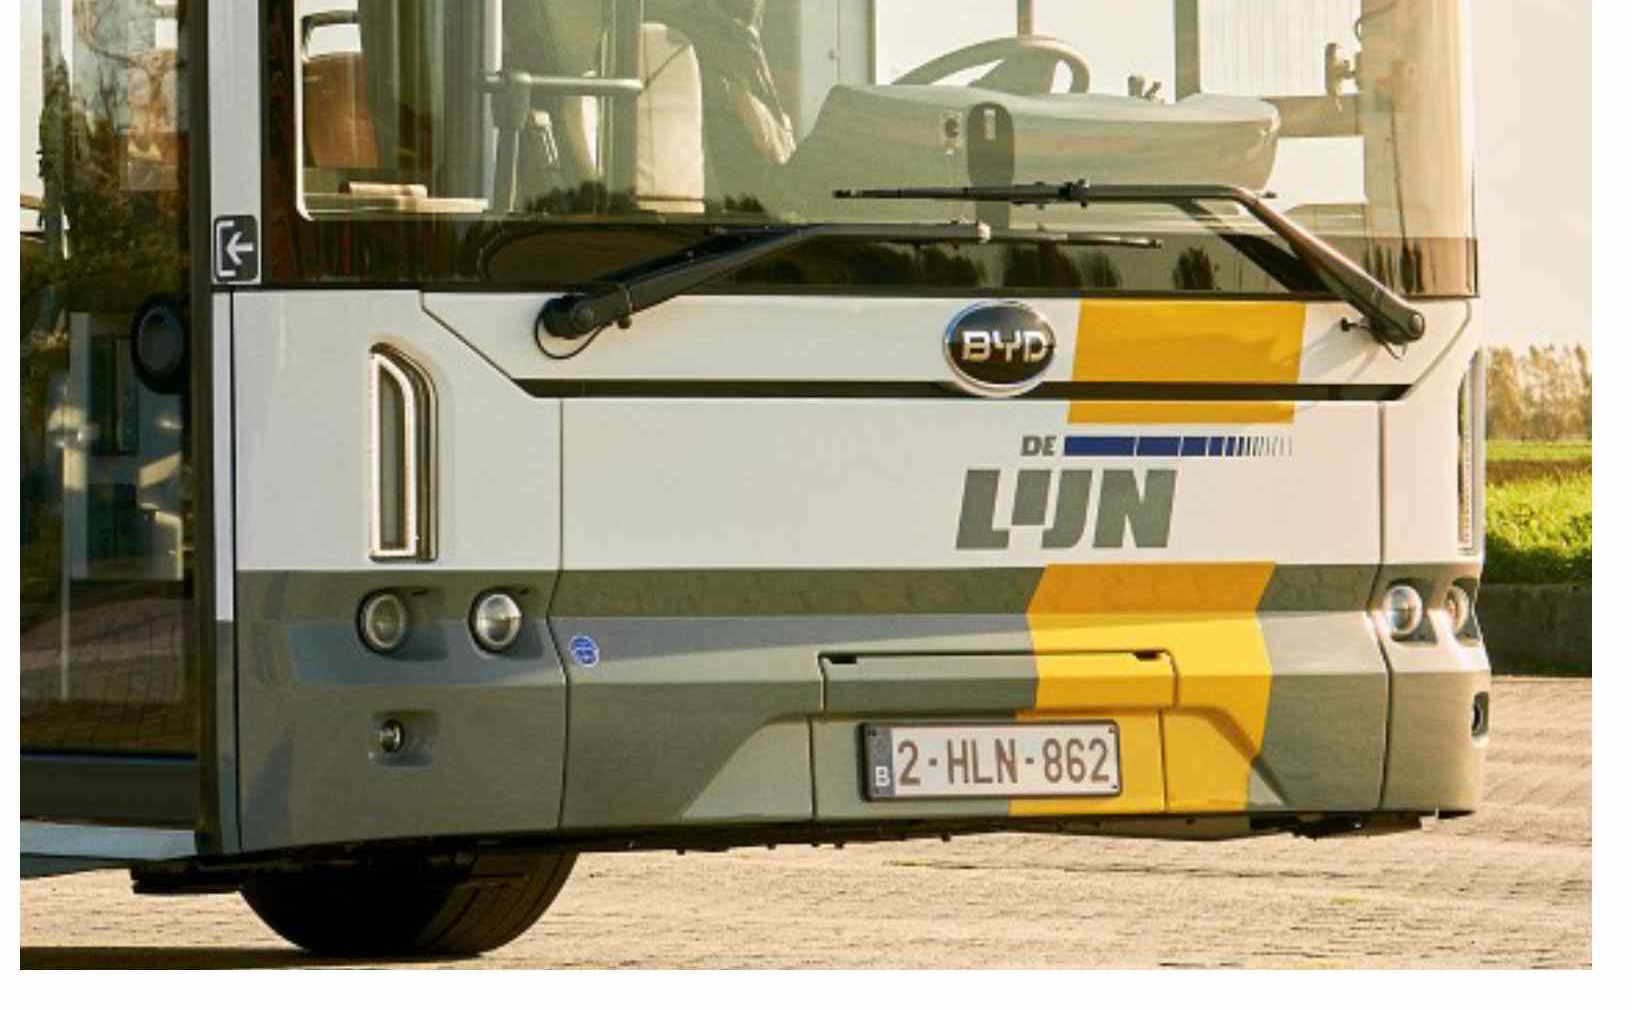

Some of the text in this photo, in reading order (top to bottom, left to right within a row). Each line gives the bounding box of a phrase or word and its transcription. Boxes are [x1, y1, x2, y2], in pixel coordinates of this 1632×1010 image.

[961, 330, 1049, 363] BYD
[1020, 435, 1057, 457] DE
[956, 468, 1178, 550] LIJN
[875, 737, 1110, 787] B 2-HLN-862
